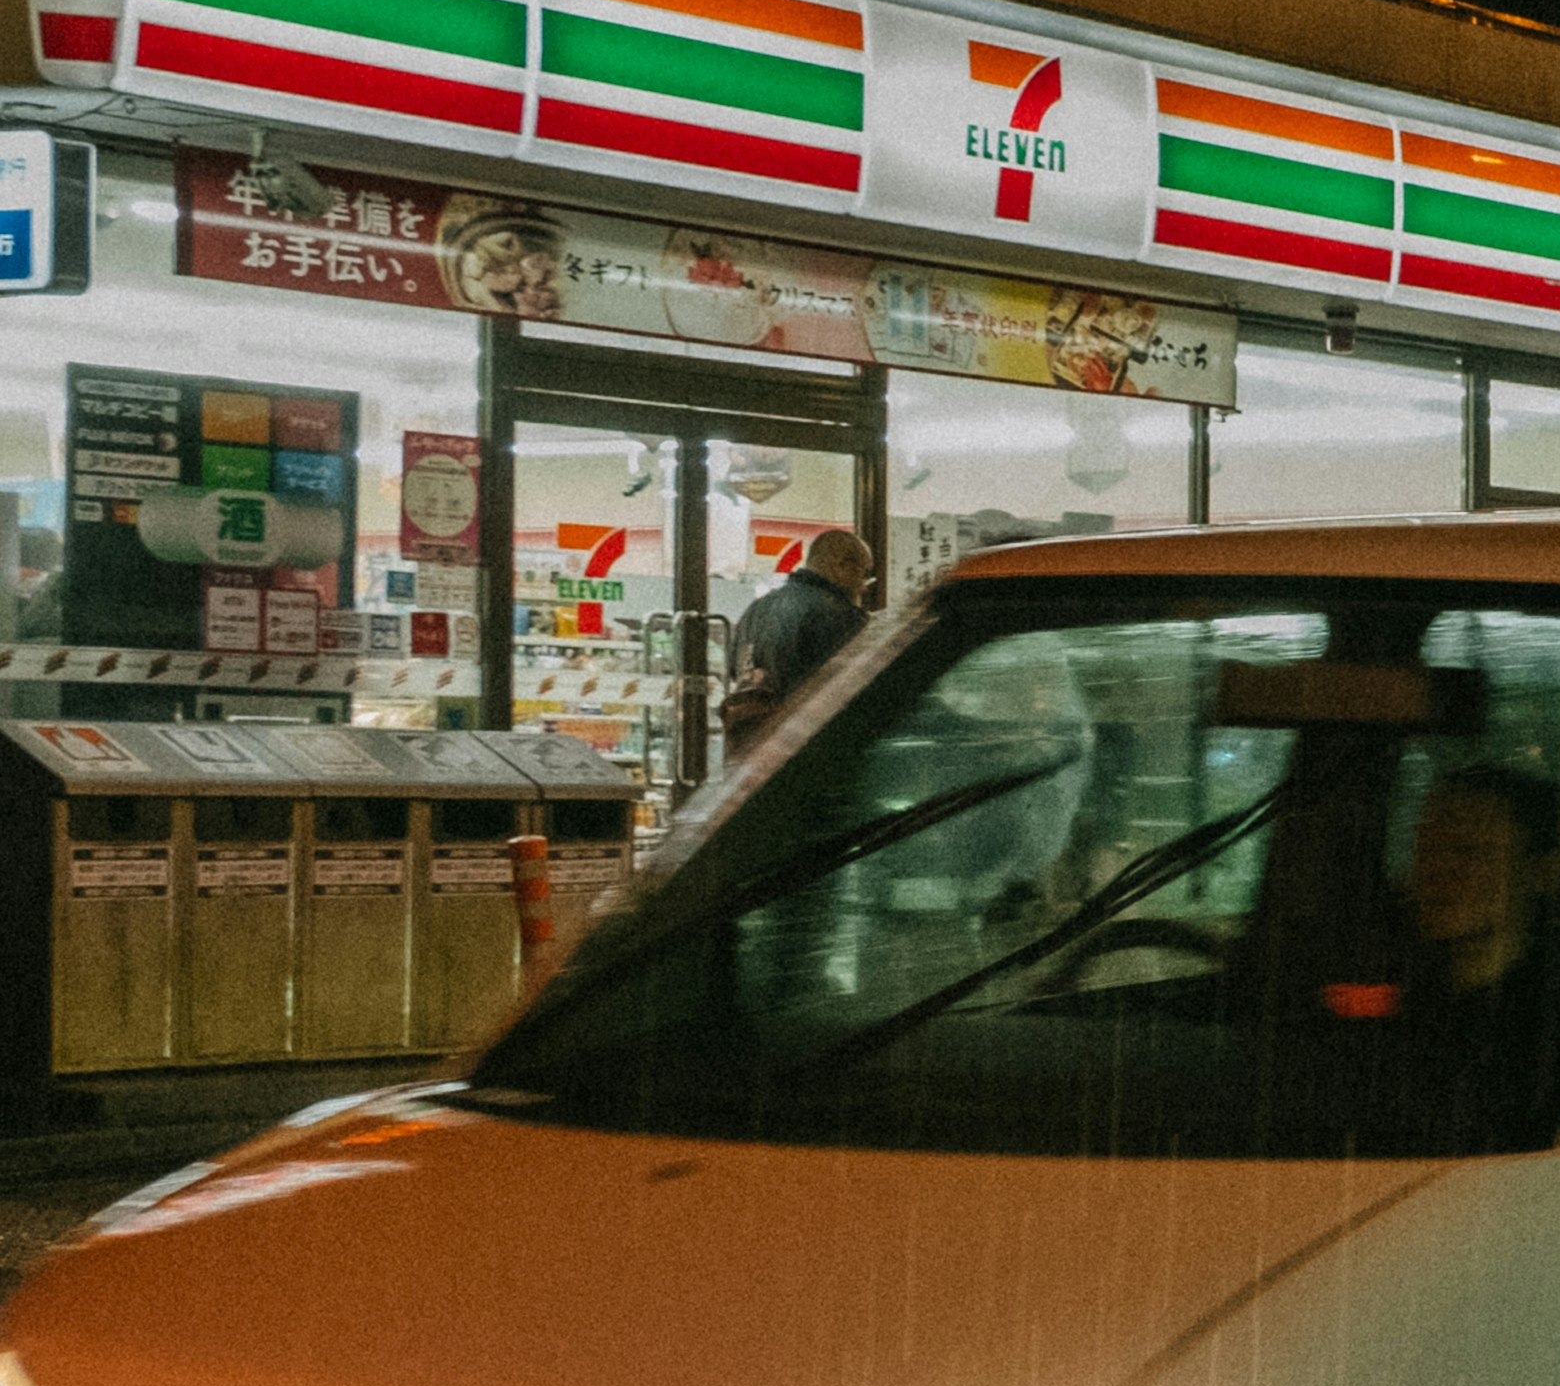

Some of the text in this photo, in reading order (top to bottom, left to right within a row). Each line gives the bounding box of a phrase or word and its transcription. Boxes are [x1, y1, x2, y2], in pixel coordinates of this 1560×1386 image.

[241, 231, 418, 293] お手伝い。
[218, 497, 266, 543] 酒
